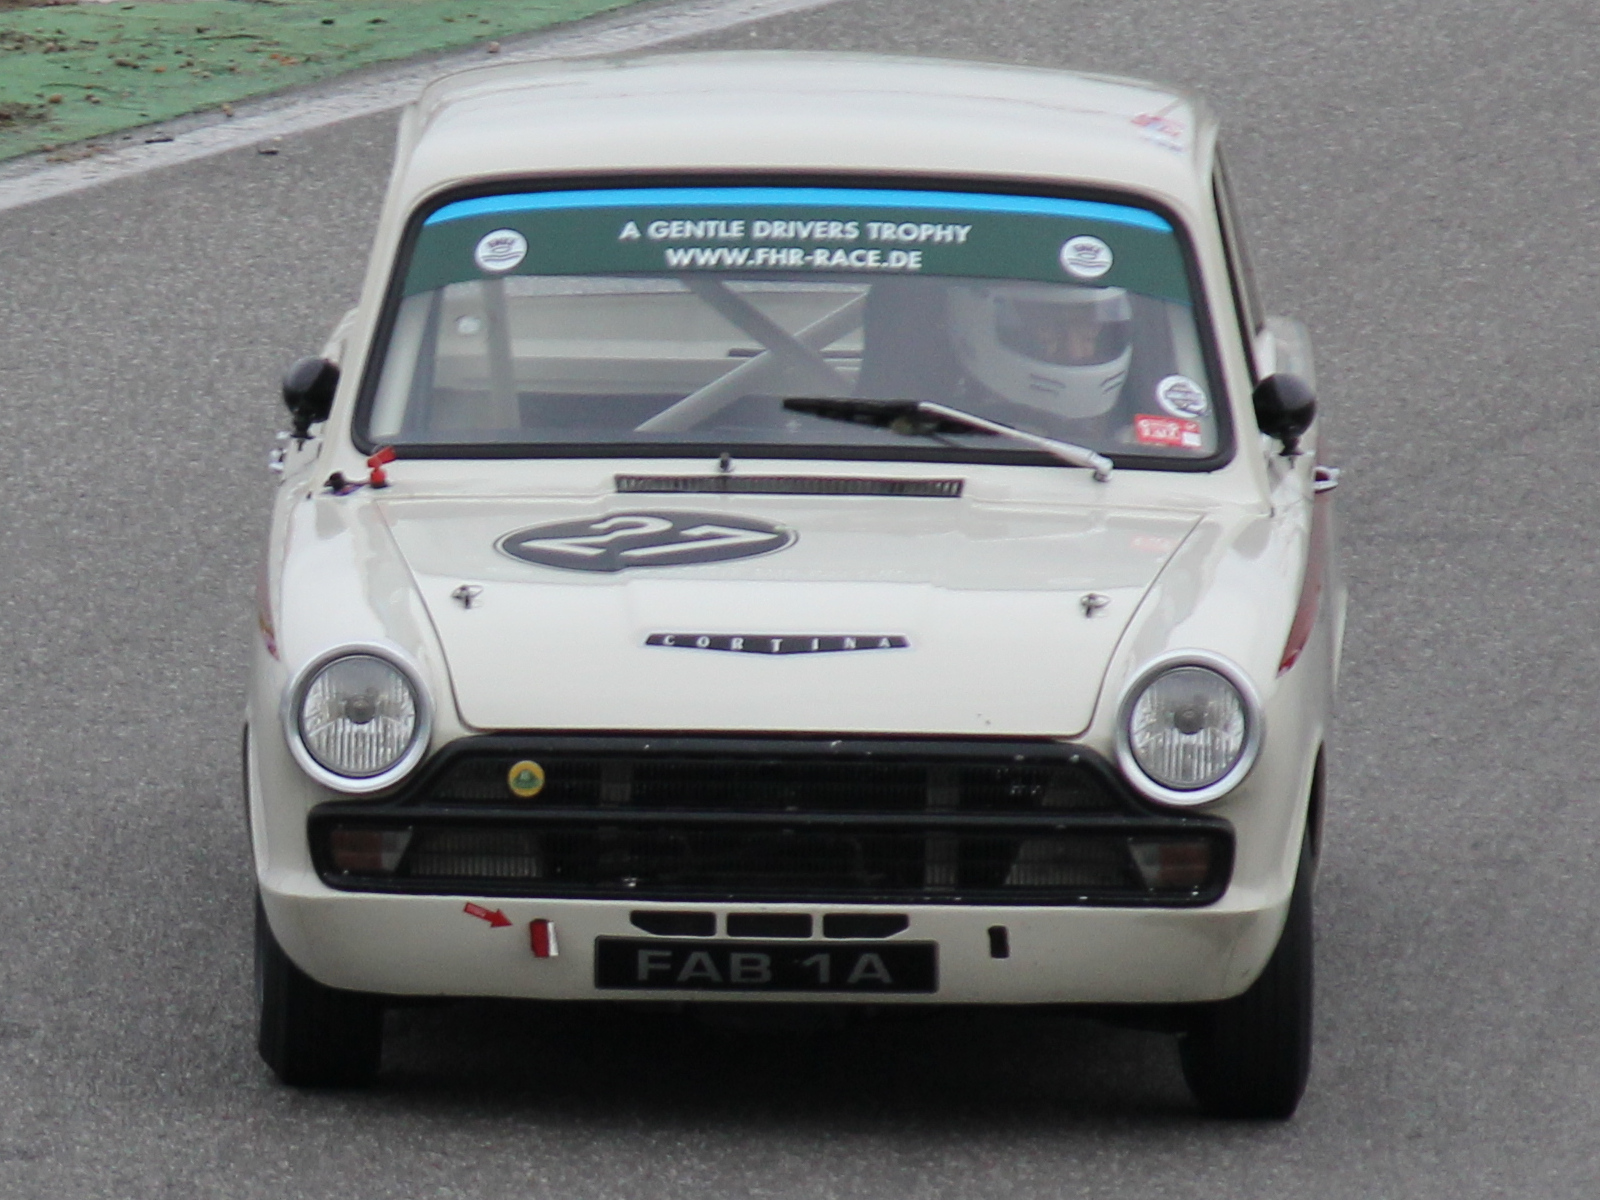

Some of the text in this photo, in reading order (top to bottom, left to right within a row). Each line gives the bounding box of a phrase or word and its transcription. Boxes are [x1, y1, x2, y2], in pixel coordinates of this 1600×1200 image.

[619, 220, 972, 243] A GENTLE DRIVERS TROPHY
[665, 248, 922, 268] WWW.FHR-RACE.DE
[662, 634, 890, 653] CORTINA
[637, 950, 773, 983] FAB
